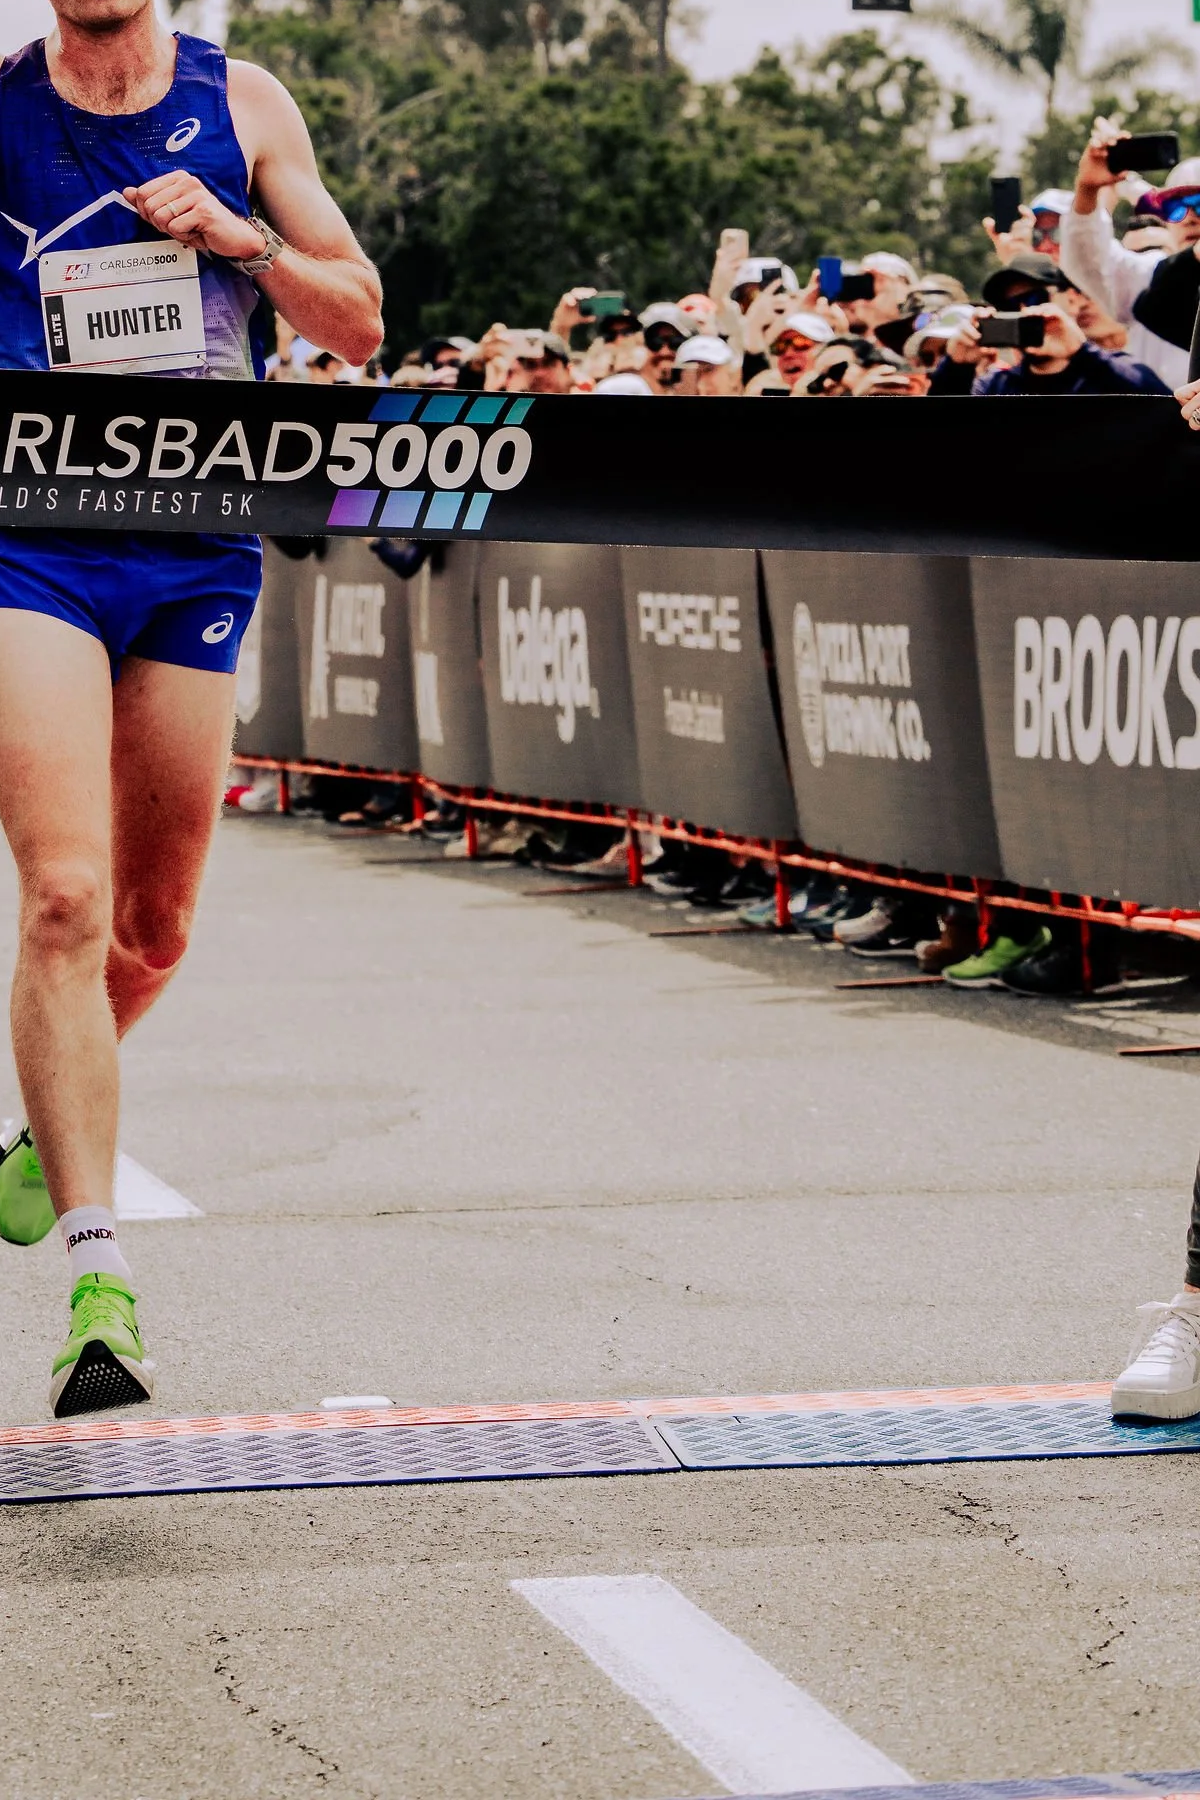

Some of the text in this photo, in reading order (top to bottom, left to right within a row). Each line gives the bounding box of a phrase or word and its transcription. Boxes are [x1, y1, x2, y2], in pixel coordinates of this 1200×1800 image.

[99, 253, 178, 271] CARLSBAD5000
[51, 313, 64, 347] ELITE
[87, 304, 182, 340] HUNTER
[78, 488, 202, 515] FASTEST
[221, 494, 254, 517] 5K
[638, 593, 742, 653] PORSCHE
[1014, 614, 1200, 770] BROOKS
